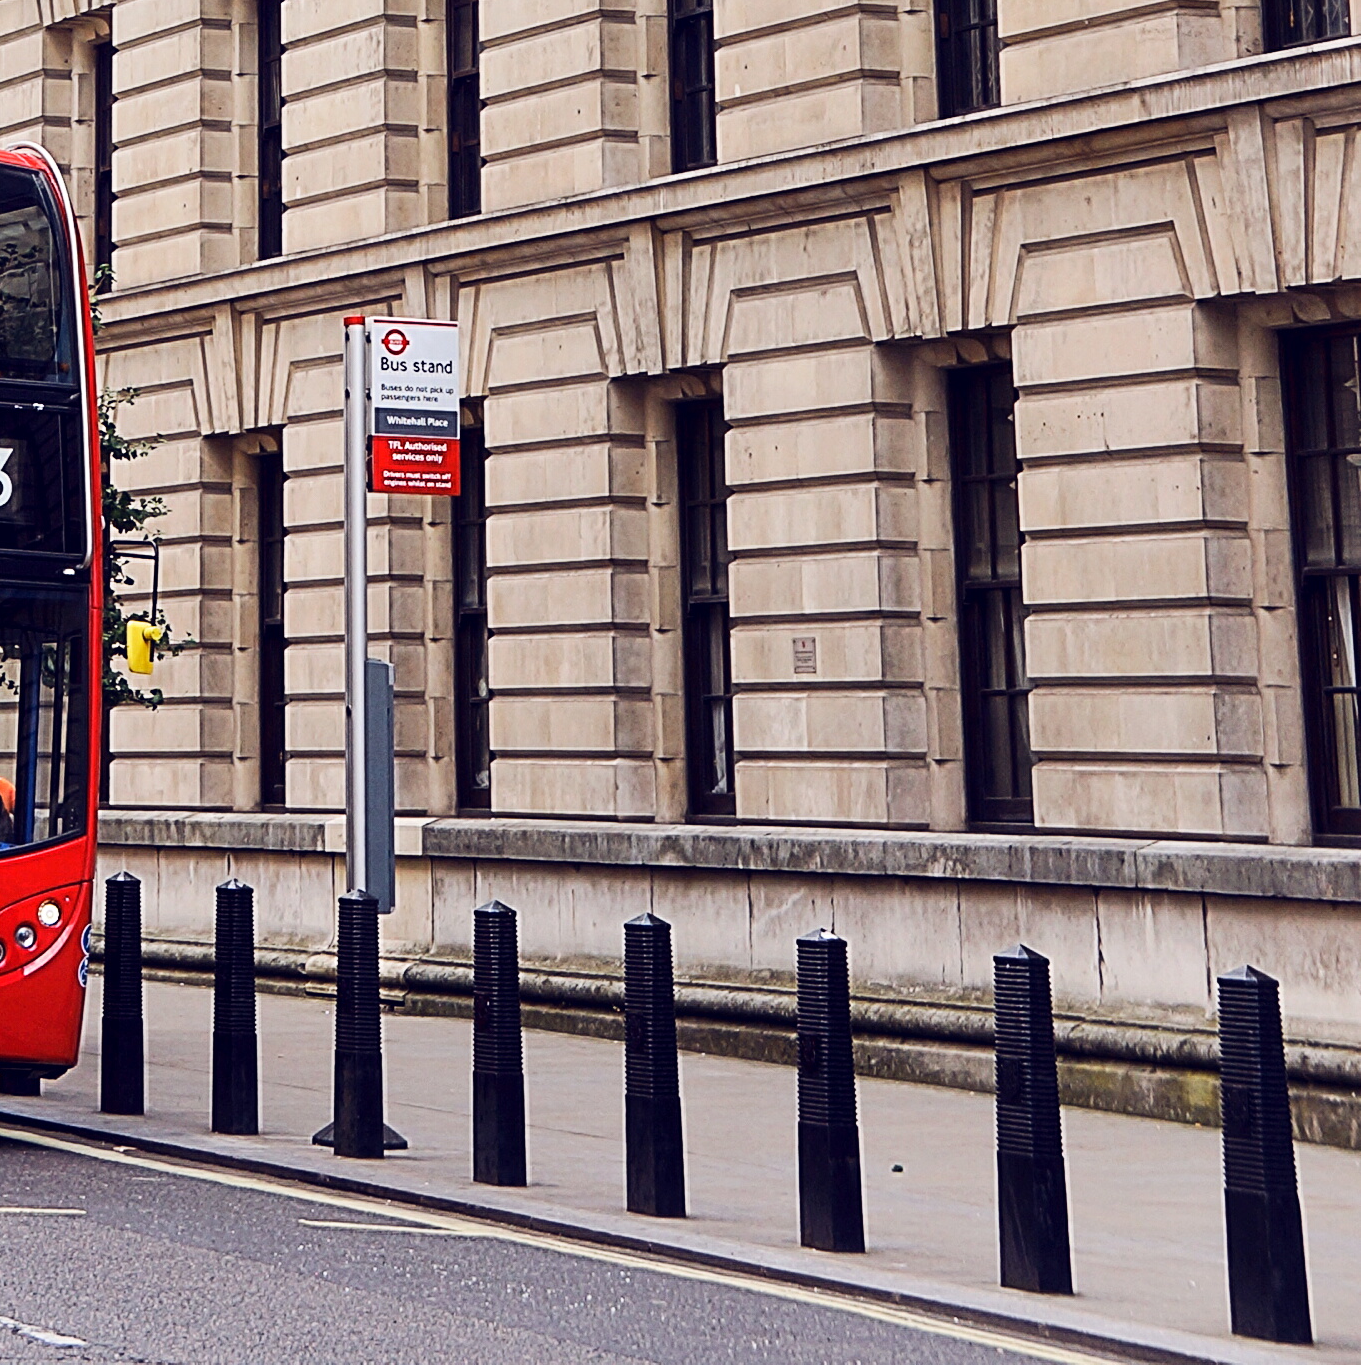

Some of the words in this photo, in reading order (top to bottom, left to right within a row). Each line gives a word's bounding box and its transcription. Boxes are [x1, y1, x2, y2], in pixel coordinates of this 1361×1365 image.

[381, 357, 407, 371] Bus
[413, 360, 452, 374] stand
[430, 386, 443, 394] pick
[386, 416, 426, 426] Whitehall
[427, 417, 448, 427] Place
[404, 442, 447, 451] Authorised
[392, 453, 424, 461] services
[426, 454, 443, 464] only
